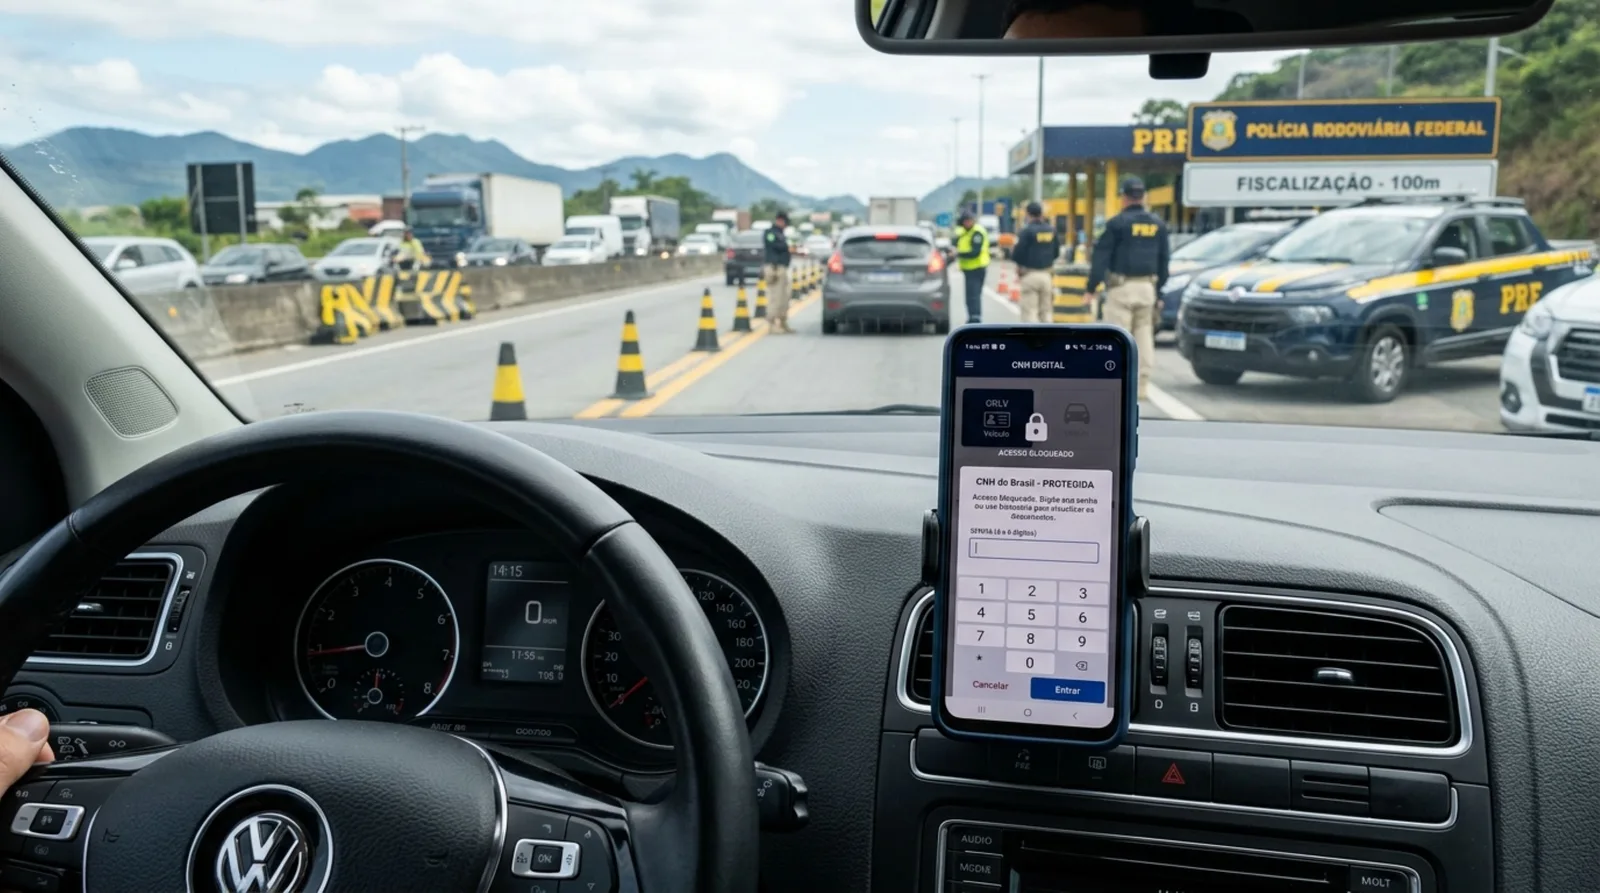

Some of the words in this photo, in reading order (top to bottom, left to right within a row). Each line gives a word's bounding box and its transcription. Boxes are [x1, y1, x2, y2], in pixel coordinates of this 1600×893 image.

[1246, 120, 1308, 138] POLÍCIA
[1312, 117, 1411, 138] RODOVIÁRIA
[1414, 119, 1487, 136] FEDERAL
[1236, 172, 1372, 195] FISCALIZAÇÃO
[1392, 175, 1440, 189] 100m
[1500, 281, 1543, 314] PRF
[1011, 361, 1031, 369] CNH
[1031, 361, 1066, 369] DIGITAL
[975, 477, 996, 486] CNH
[997, 478, 1008, 487] do
[1010, 478, 1035, 488] Brasil
[1042, 480, 1095, 489] PROTEGIDA
[493, 564, 524, 578] 14:15
[384, 577, 393, 588] 4
[352, 586, 360, 598] 3
[416, 588, 425, 599] 5
[698, 591, 715, 600] 120
[978, 583, 985, 595] 1
[1028, 585, 1037, 597] 2
[1078, 587, 1088, 600] 3
[525, 600, 542, 624] 0
[715, 603, 734, 613] 140
[327, 609, 336, 621] 2
[437, 614, 446, 625] 6
[976, 606, 986, 618] 4
[1027, 608, 1036, 621] 5
[1078, 611, 1087, 624] 6
[727, 619, 746, 629] 160
[608, 631, 621, 641] 30
[735, 637, 754, 647] 180
[976, 629, 985, 642] 7
[1026, 632, 1035, 645] 8
[1077, 635, 1087, 648] 9
[442, 649, 450, 661] 7
[604, 651, 619, 661] 20
[734, 658, 756, 668] 200
[1025, 657, 1034, 669] 0
[327, 677, 336, 689] 0
[606, 673, 618, 683] 10
[423, 682, 432, 694] 8
[972, 680, 1009, 691] Cancelar
[1055, 685, 1082, 696] Entrar
[961, 835, 993, 845] AUDIO
[1361, 876, 1391, 888] MOLT
